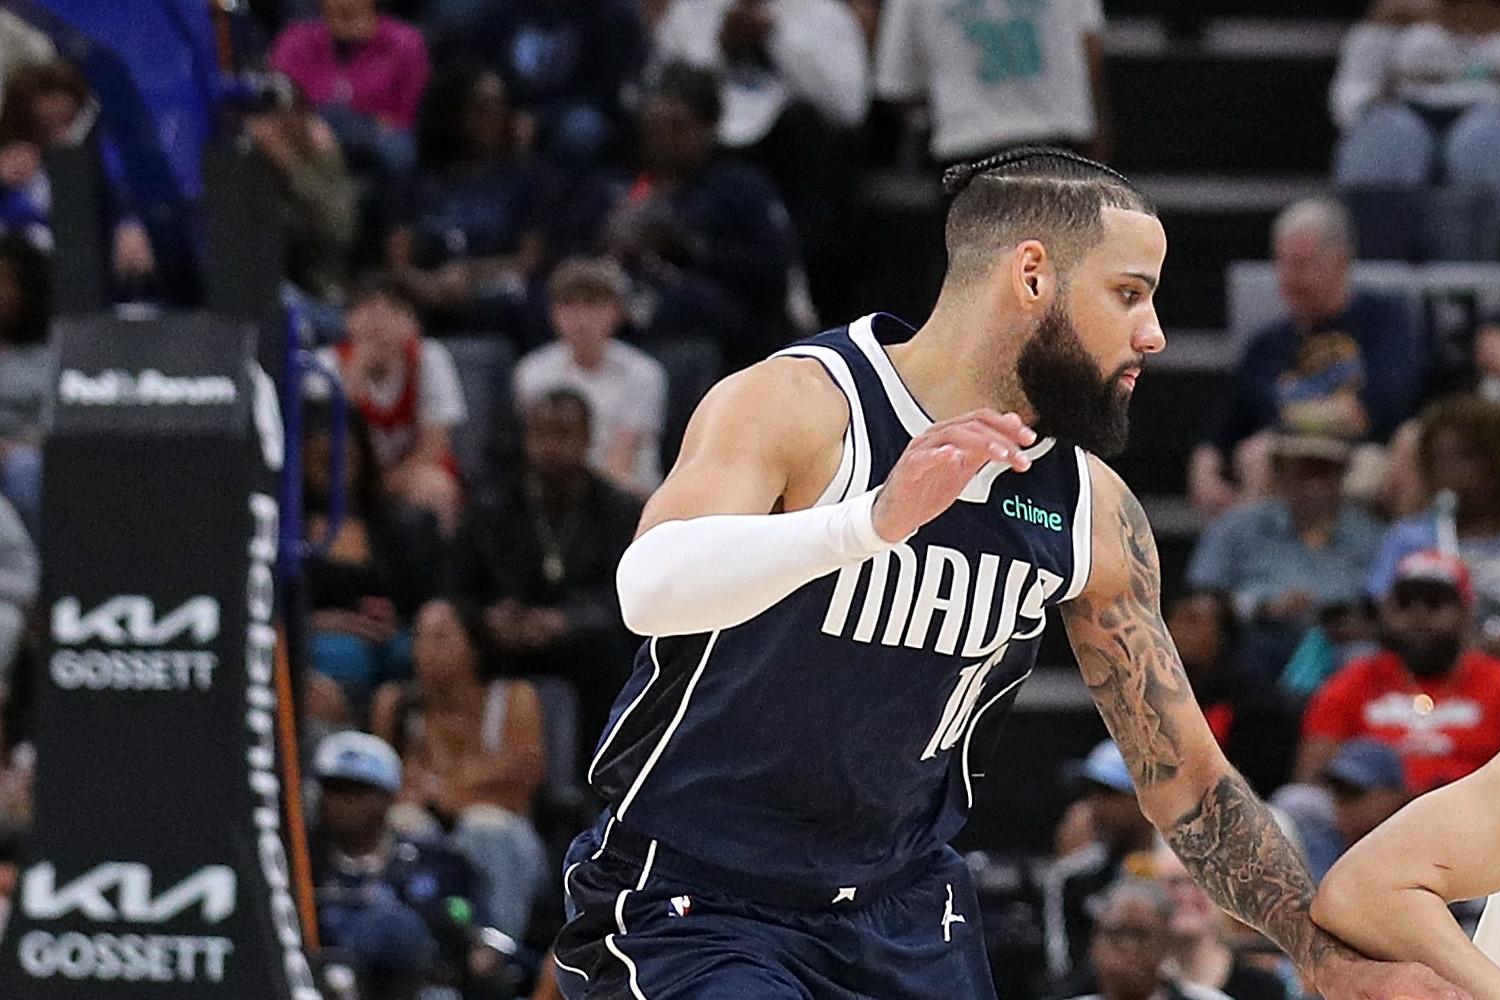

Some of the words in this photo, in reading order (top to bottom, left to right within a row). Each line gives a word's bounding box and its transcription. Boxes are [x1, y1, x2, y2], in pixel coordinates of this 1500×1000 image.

[1003, 494, 1063, 531] chime
[49, 649, 219, 689] GOSSETT
[18, 930, 234, 982] GOSSETT
